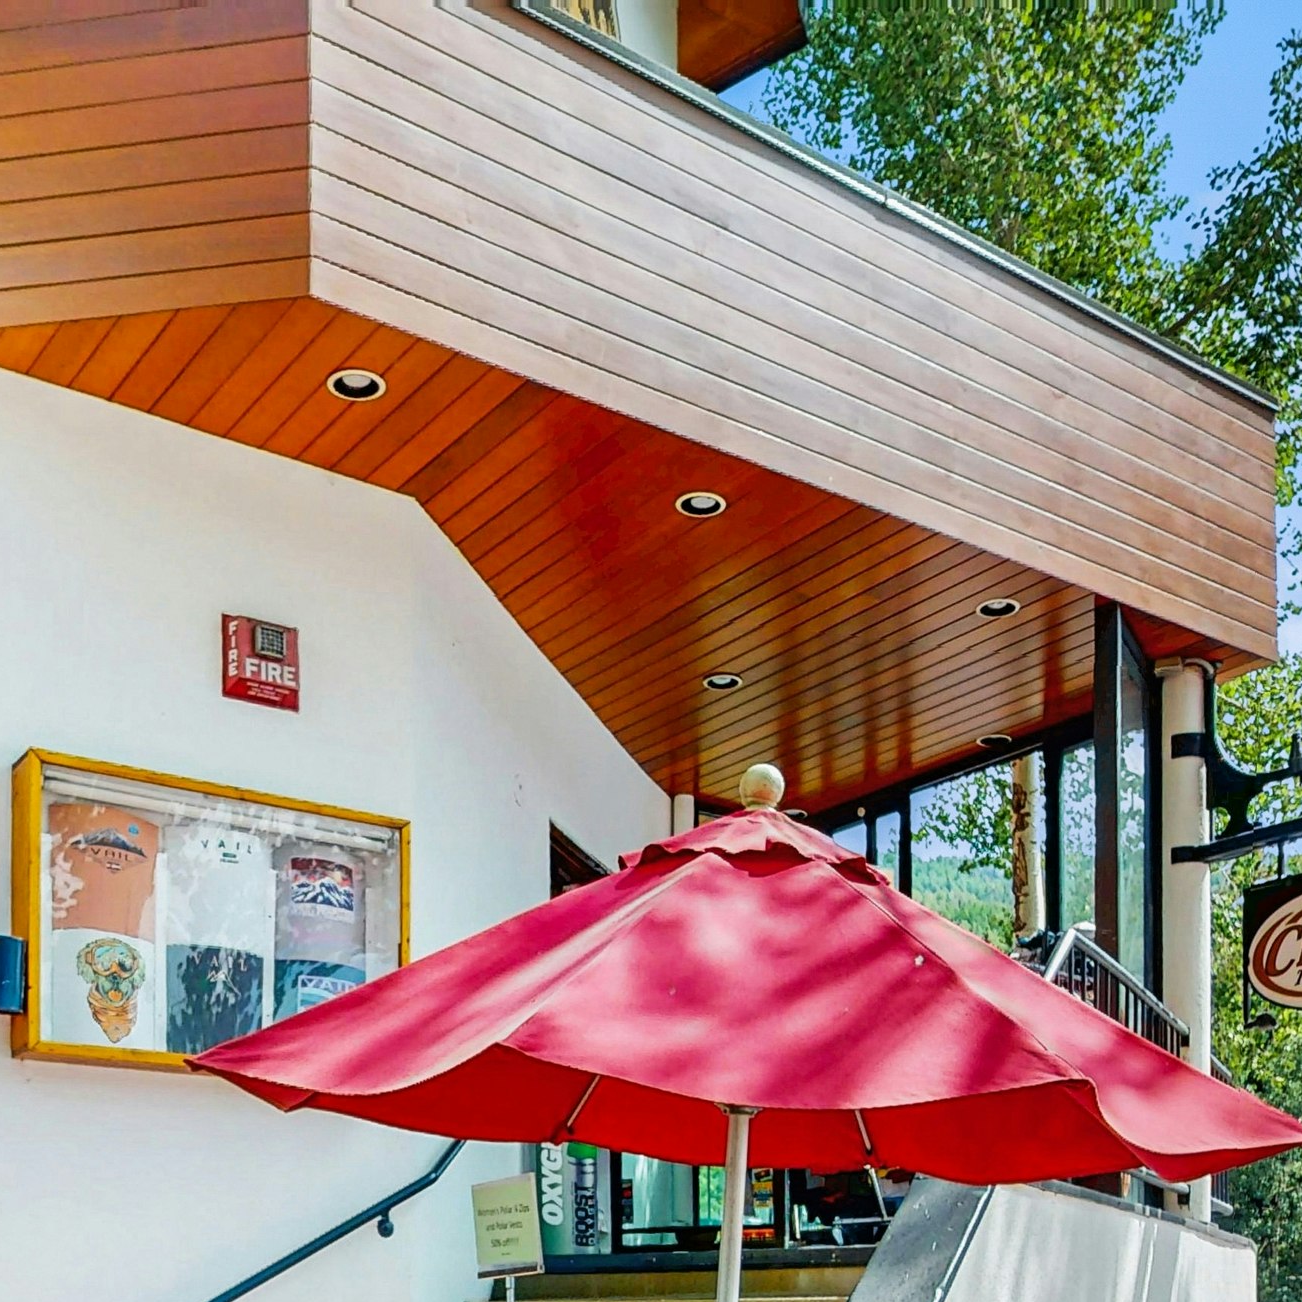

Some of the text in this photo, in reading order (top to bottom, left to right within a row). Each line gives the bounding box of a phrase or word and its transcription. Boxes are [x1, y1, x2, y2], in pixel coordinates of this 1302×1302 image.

[228, 620, 238, 677] FIRE
[245, 657, 297, 687] FIRE
[201, 839, 252, 855] VAIL
[192, 955, 247, 972] VAIL
[574, 1183, 596, 1247] BOOST
